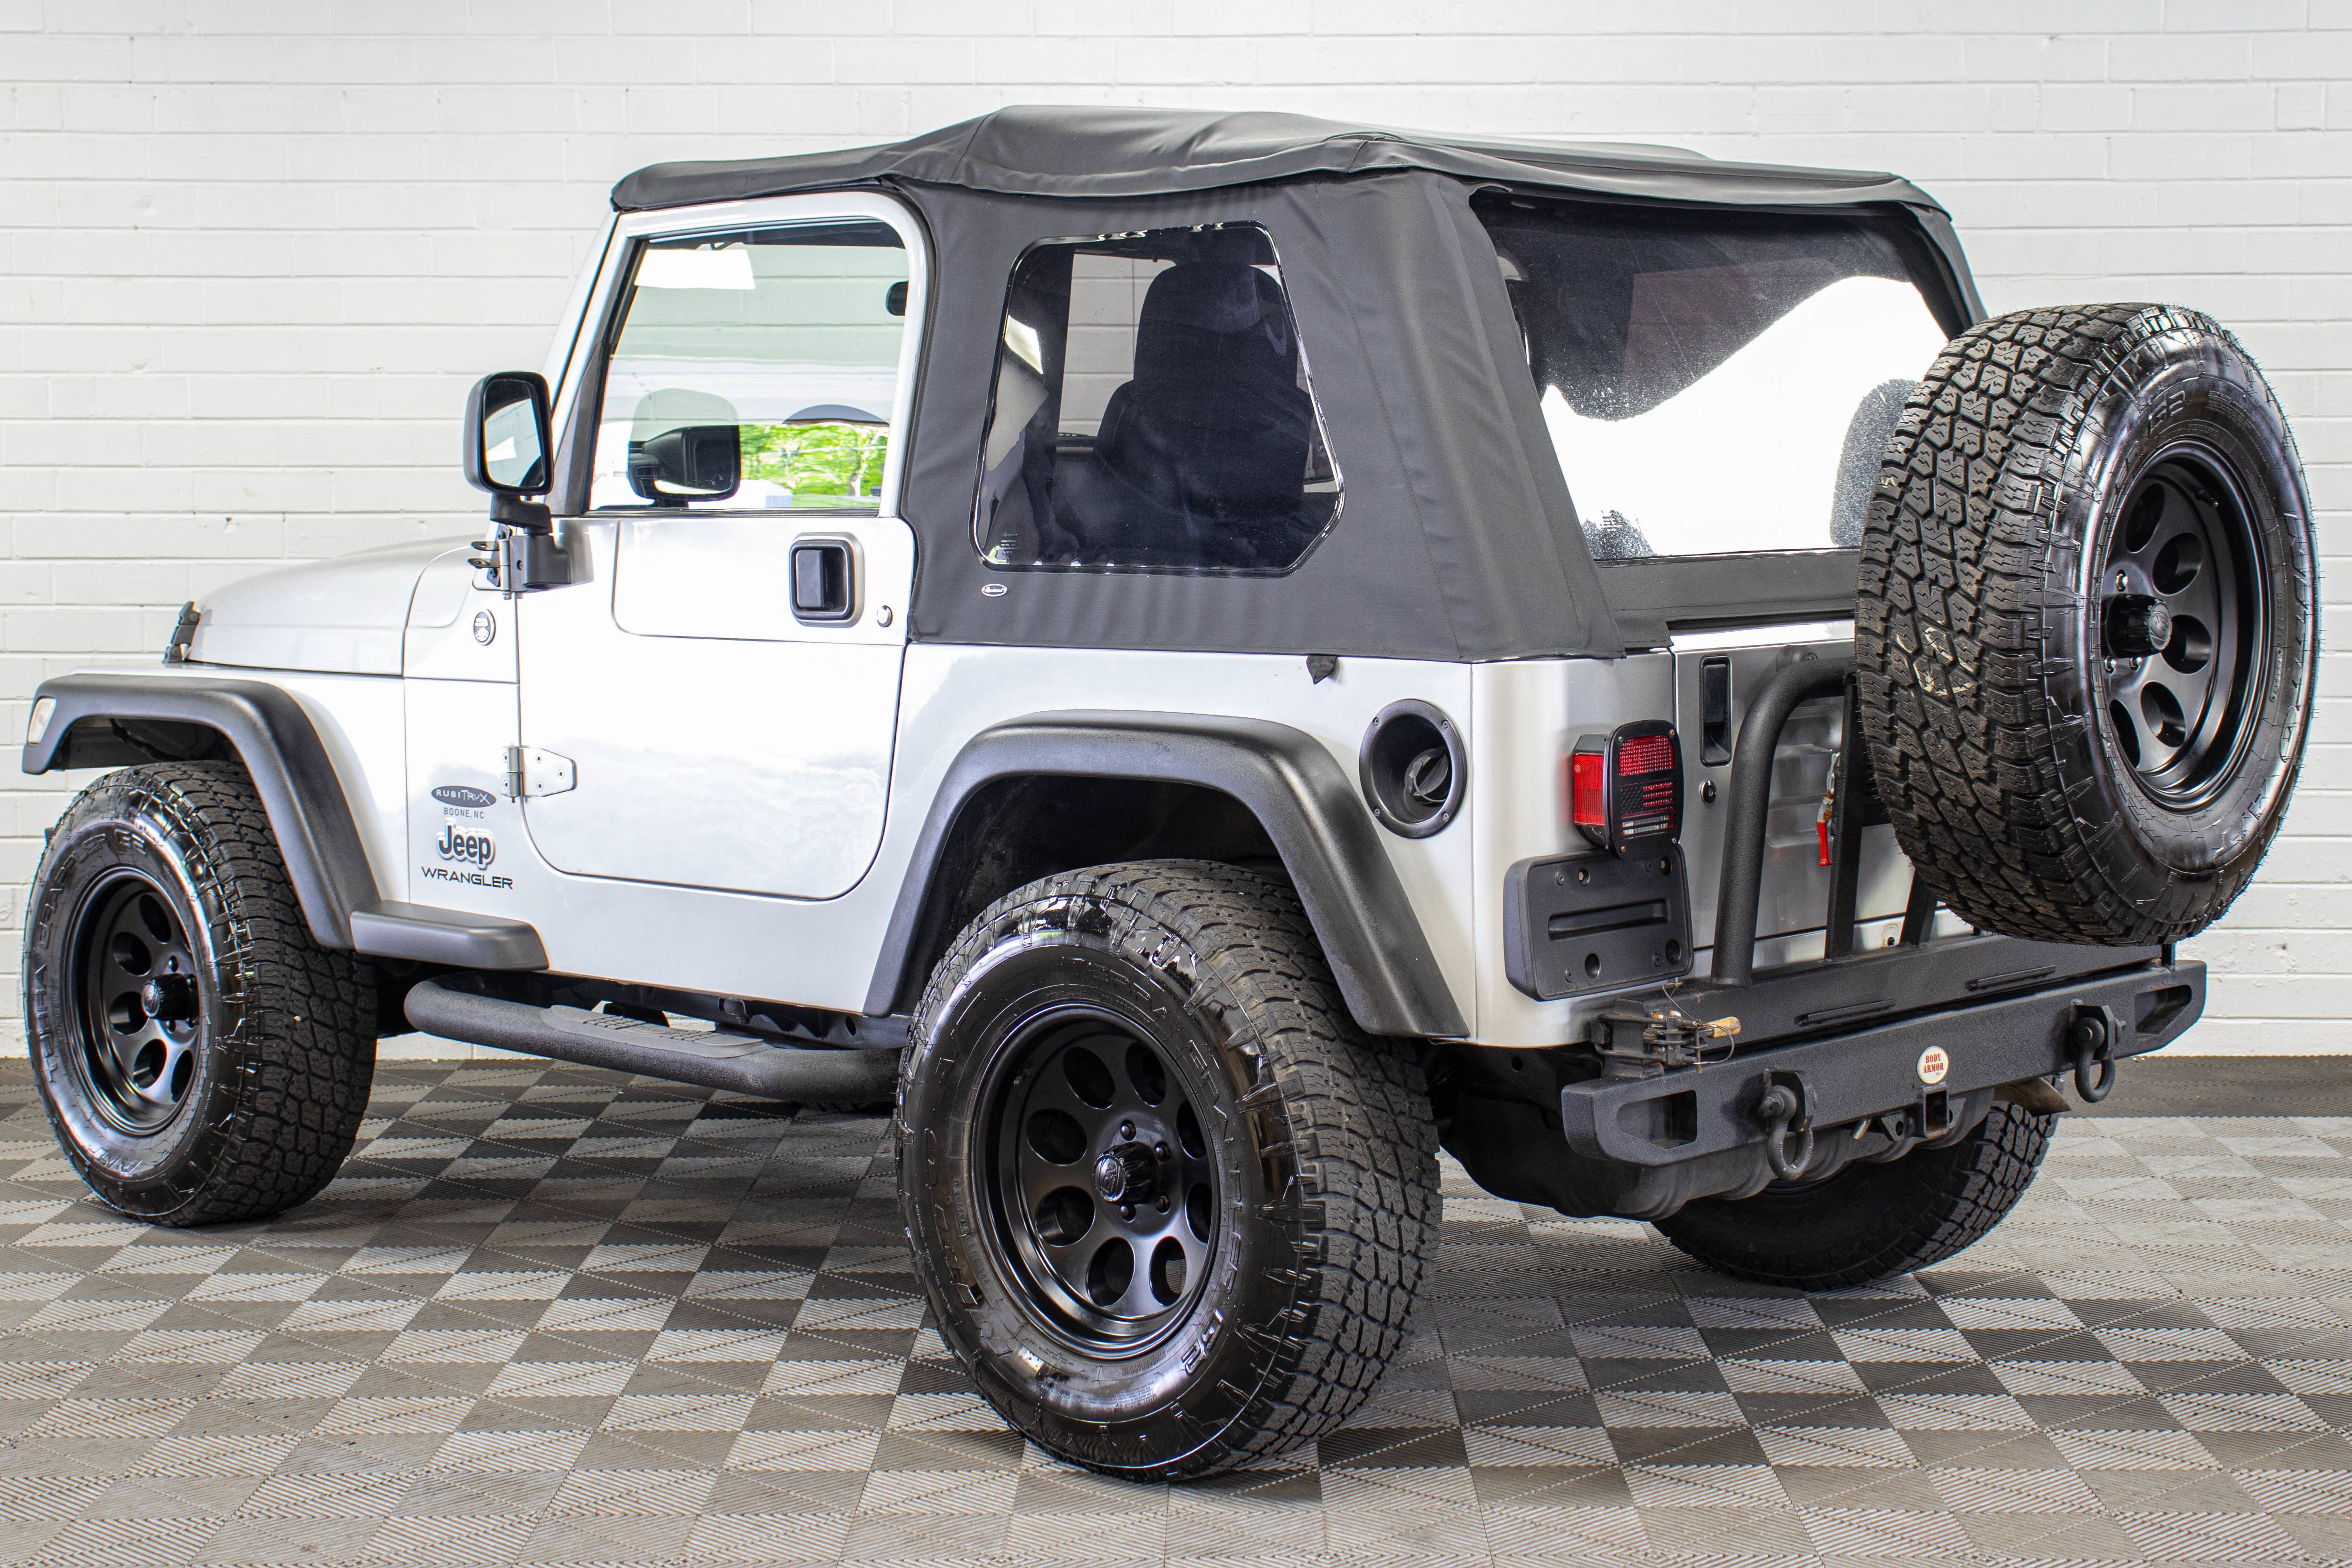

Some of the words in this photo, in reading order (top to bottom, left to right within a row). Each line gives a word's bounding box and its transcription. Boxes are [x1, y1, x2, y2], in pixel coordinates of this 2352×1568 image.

[474, 811, 484, 819] NC
[438, 825, 492, 865] Jeep
[421, 866, 513, 889] WRANGLER
[1925, 1053, 1941, 1063] BODY
[1923, 1062, 1944, 1073] ARMOR
[1181, 1308, 1224, 1375] G2
